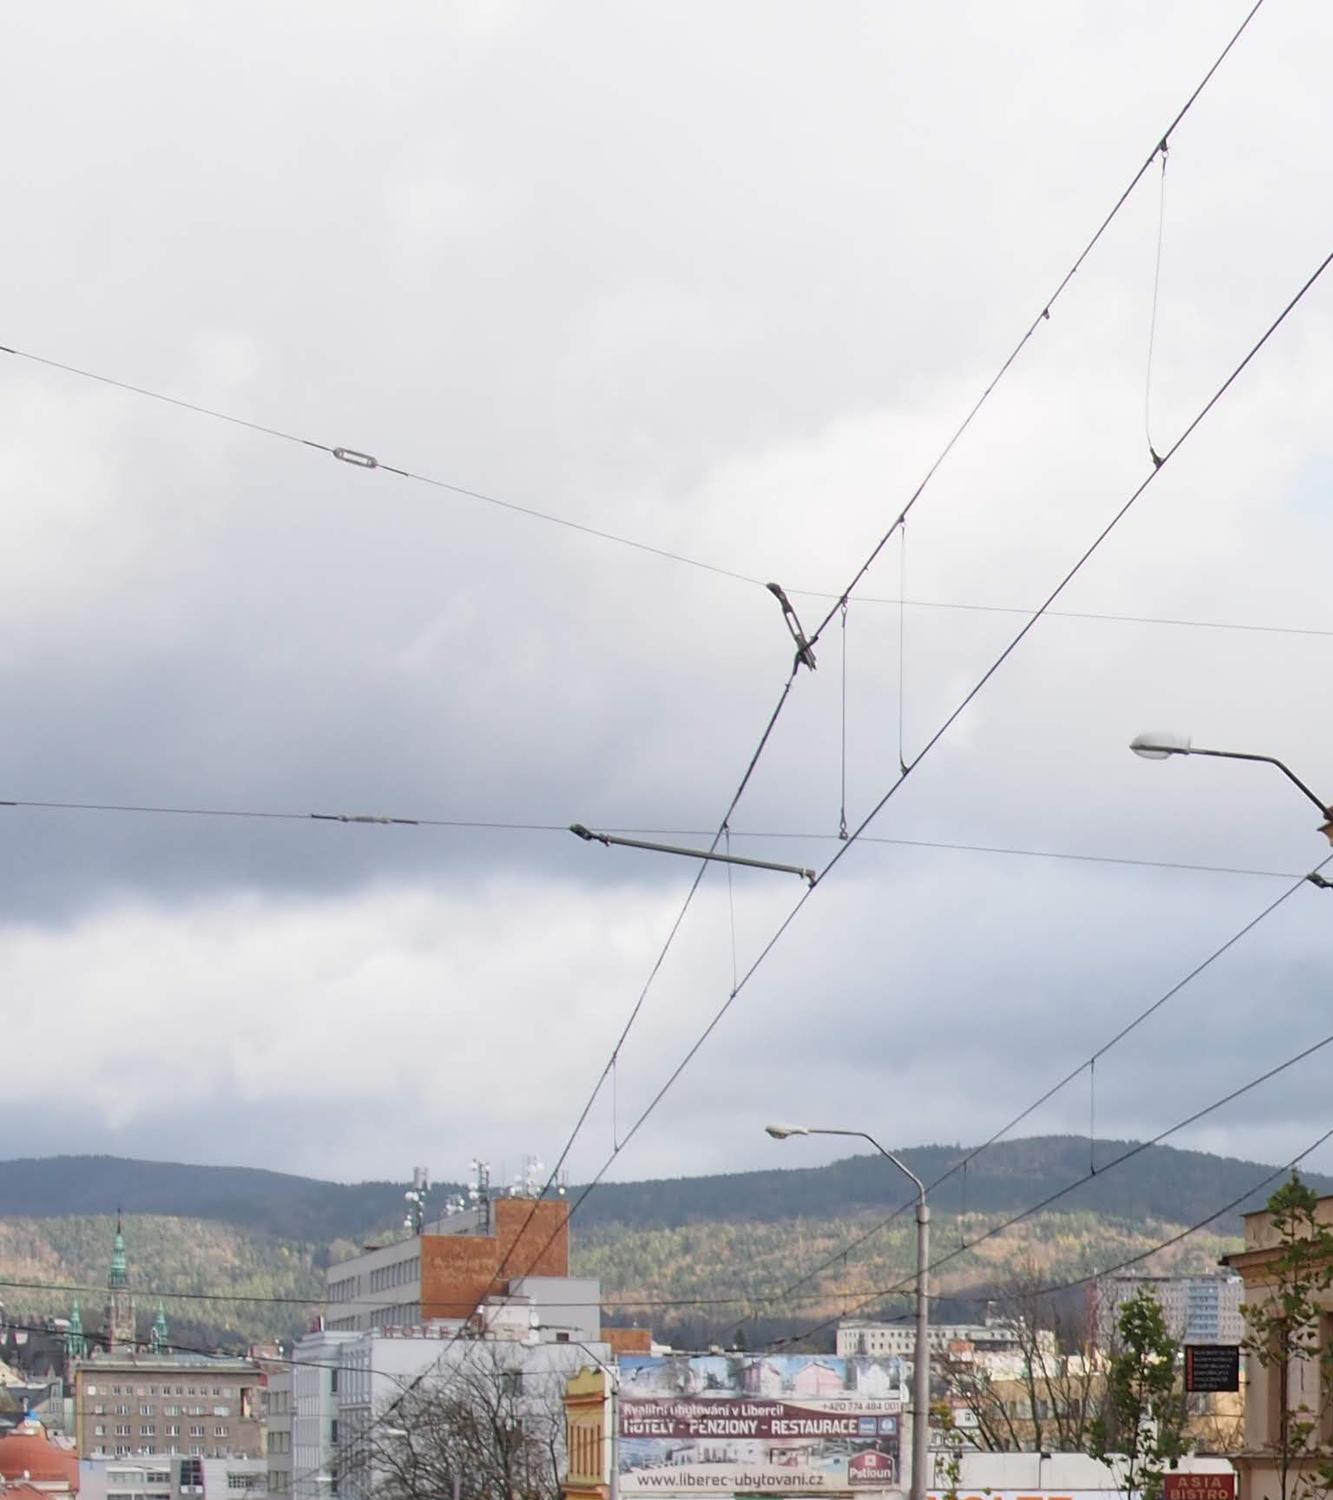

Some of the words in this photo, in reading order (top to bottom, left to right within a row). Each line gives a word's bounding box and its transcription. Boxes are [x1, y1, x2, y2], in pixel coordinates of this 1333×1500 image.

[689, 1419, 757, 1435] PENZIONY
[771, 1420, 857, 1435] RESTAURACE
[637, 1471, 824, 1487] www.liberec-ubytovani.cz
[1178, 1476, 1221, 1488] ASIA
[1170, 1489, 1228, 1500] BISTRO
